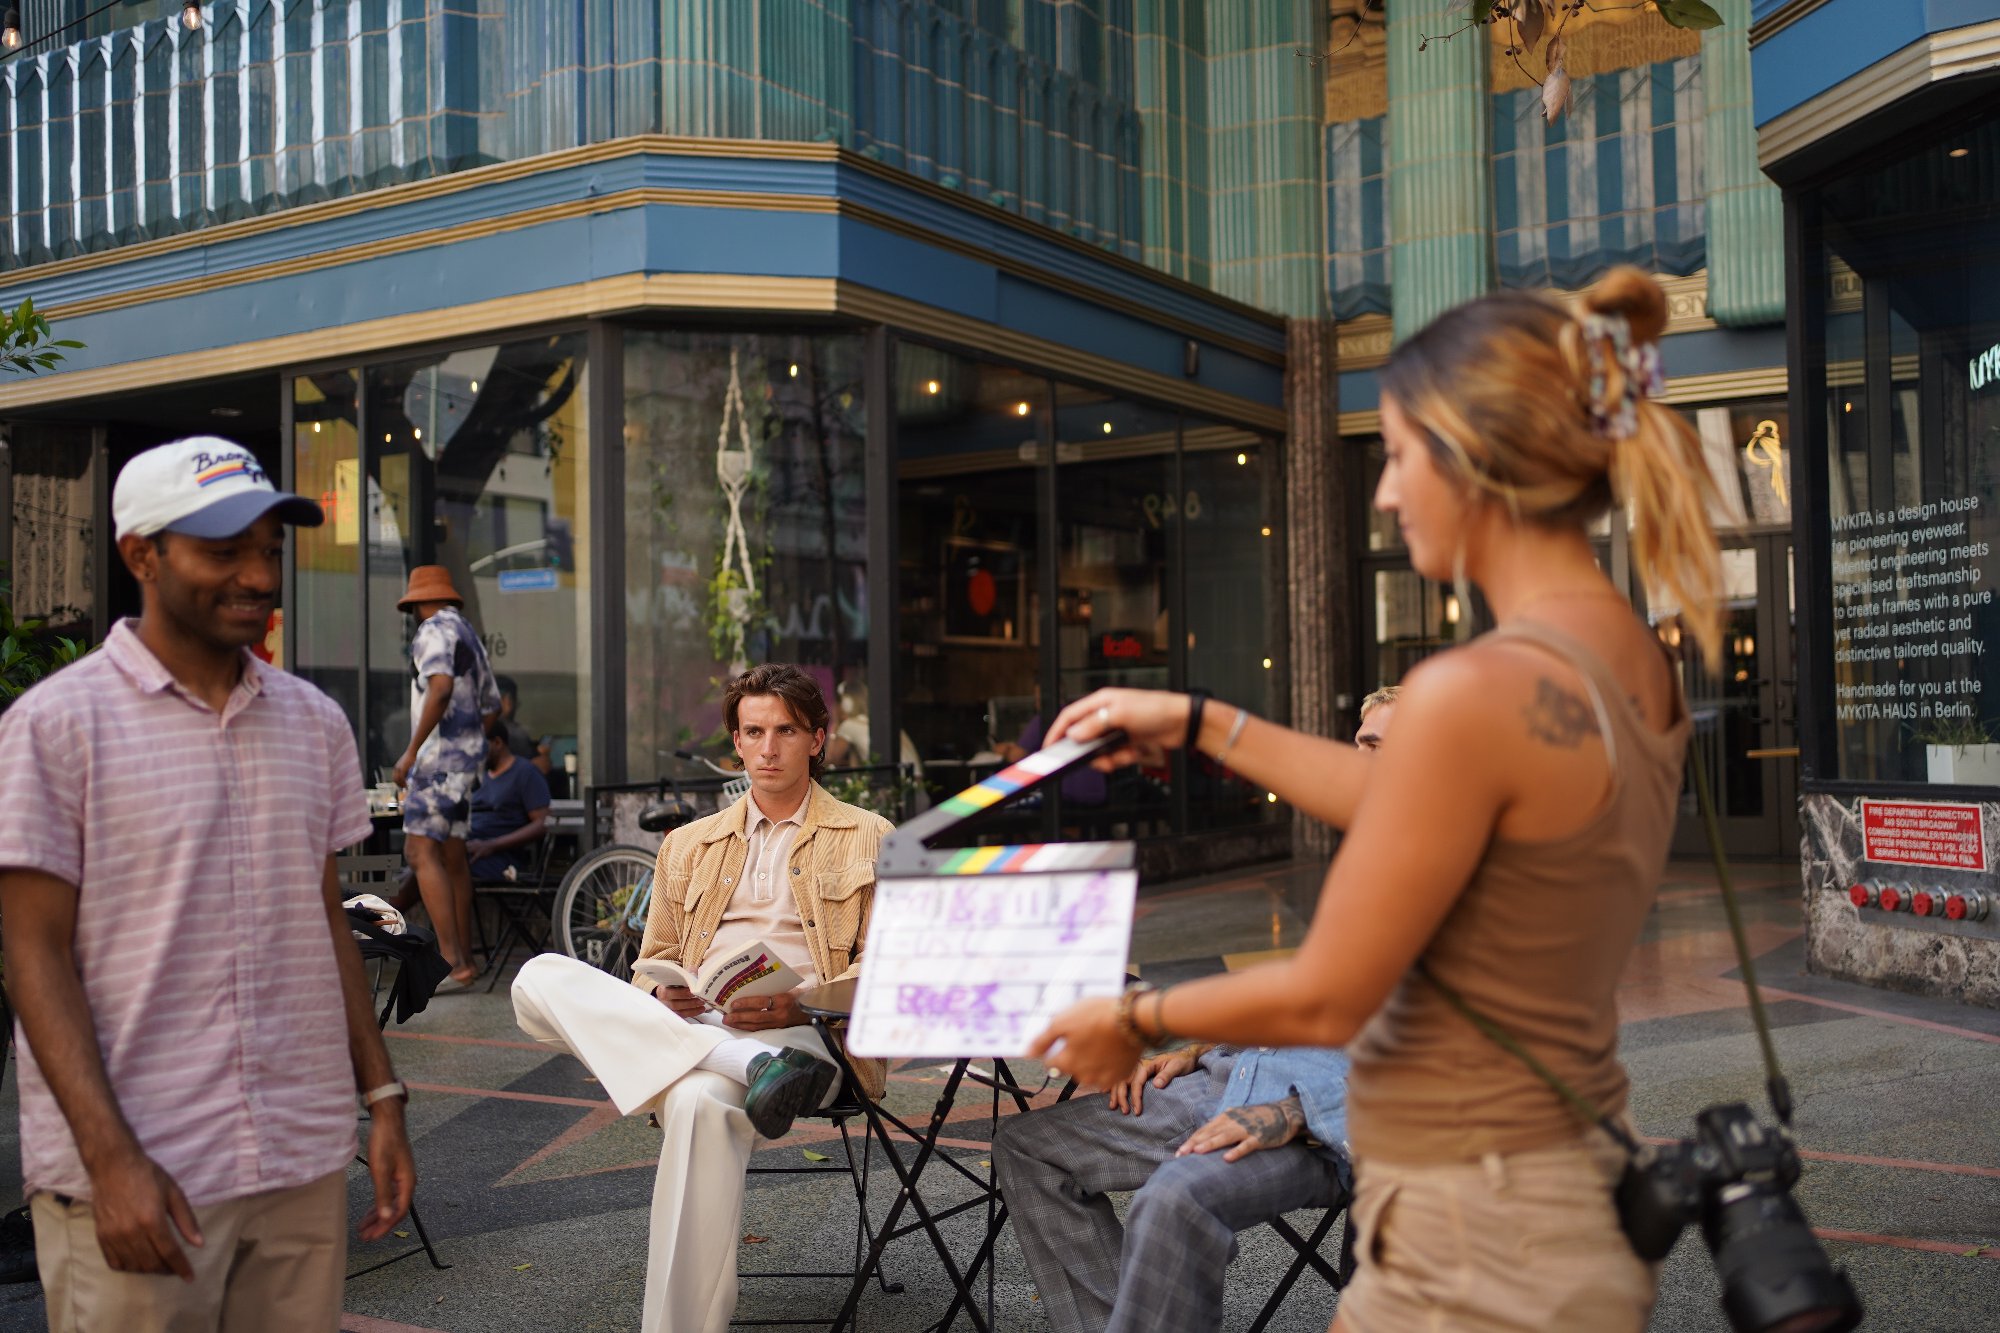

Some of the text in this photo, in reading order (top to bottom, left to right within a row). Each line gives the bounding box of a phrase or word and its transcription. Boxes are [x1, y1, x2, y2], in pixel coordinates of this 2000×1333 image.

[192, 453, 258, 475] Bron
[1831, 496, 1979, 532] MYKITA is a design house
[1831, 522, 1966, 555] for pioneering eyewear.
[1832, 542, 1989, 574] Patented engineering meets
[1833, 565, 1981, 599] specialised craftsmanship
[1833, 590, 1991, 619] to create frames with a pure
[1833, 613, 1972, 643] yet radical aesthetic and
[1835, 637, 1986, 663] distinctive tailored quality.
[1836, 677, 1982, 698] Handmade for you at the
[1836, 700, 1975, 720] MYKITA HAUS in Berlin.
[1884, 807, 1928, 818] DEPARTMENT
[1928, 809, 1973, 820] CONNECTION
